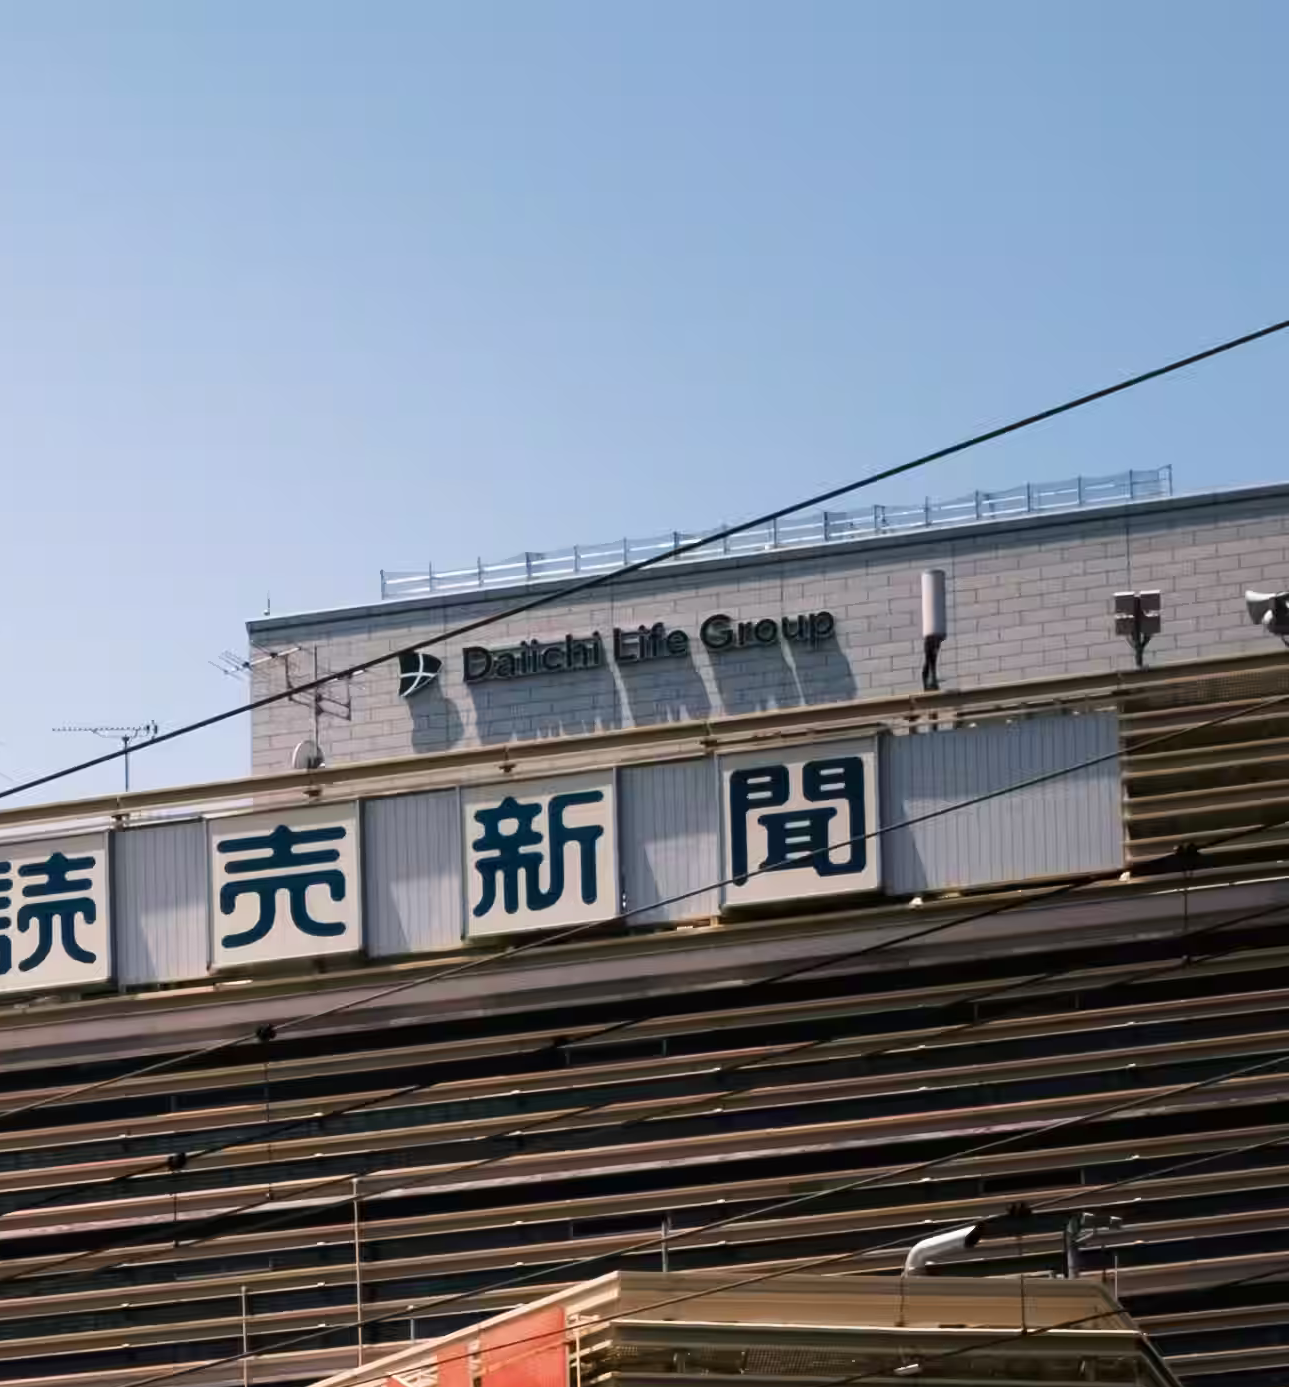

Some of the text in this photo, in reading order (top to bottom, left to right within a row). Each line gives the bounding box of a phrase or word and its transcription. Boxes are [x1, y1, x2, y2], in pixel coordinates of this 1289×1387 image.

[461, 608, 836, 684] Daiichi Life Group
